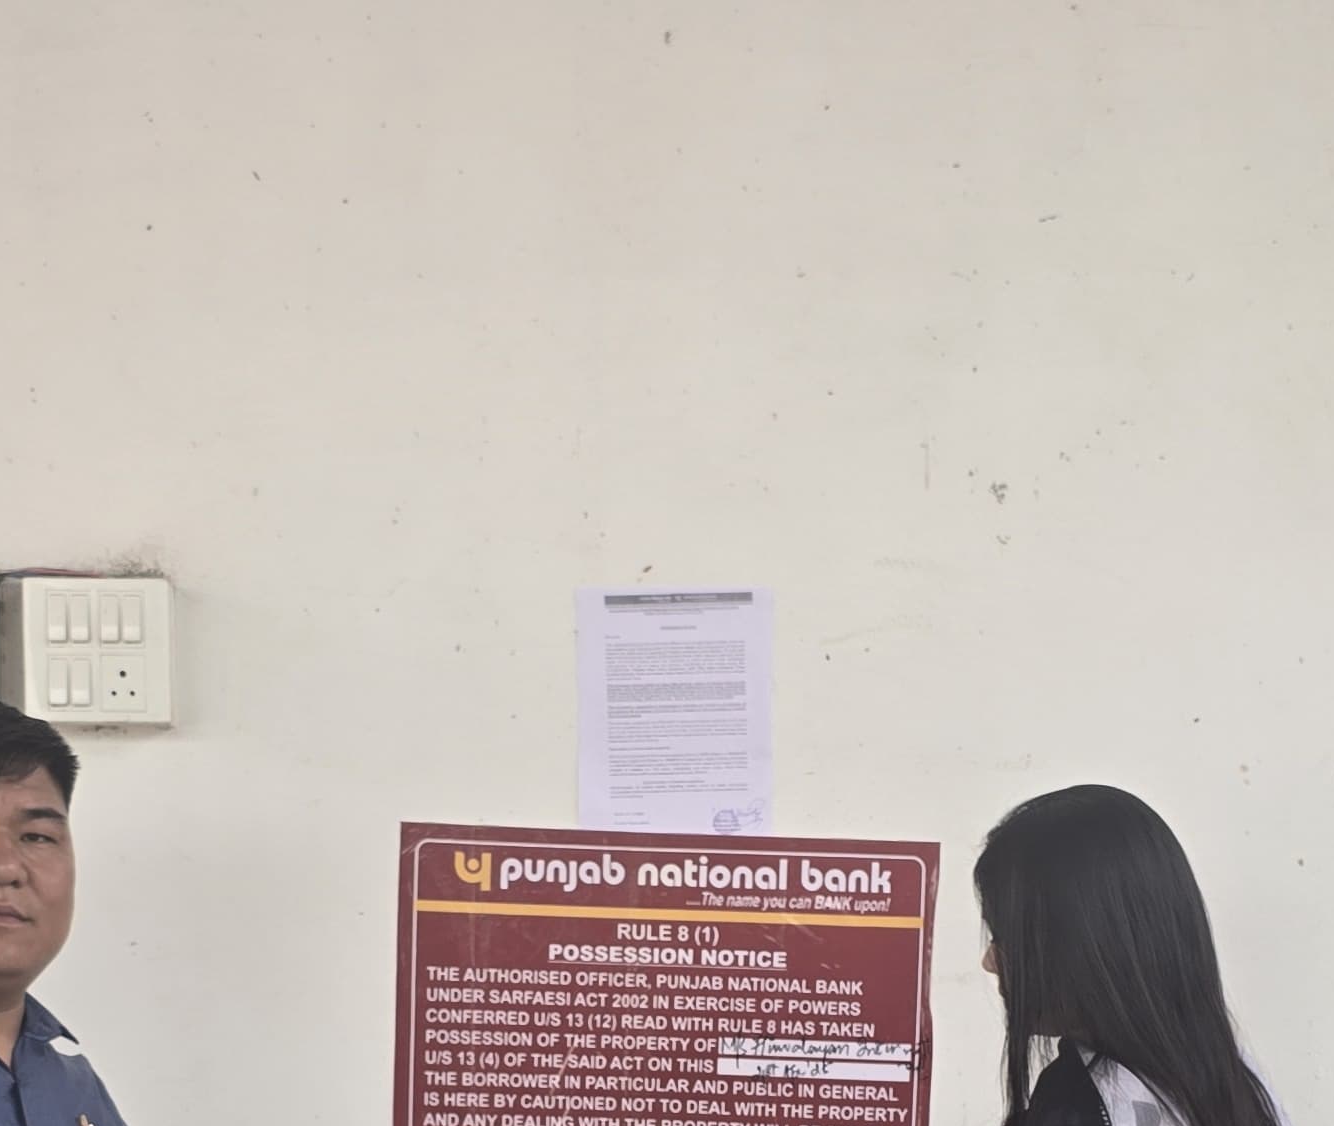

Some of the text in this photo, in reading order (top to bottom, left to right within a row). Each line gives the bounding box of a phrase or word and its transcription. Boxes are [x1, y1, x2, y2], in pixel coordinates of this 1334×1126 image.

[500, 854, 891, 893] punjab national bank
[726, 896, 760, 909] name
[762, 897, 786, 911] you
[789, 898, 811, 910] can
[814, 895, 851, 911] BANK
[854, 898, 891, 913] upon!
[617, 923, 719, 945] RULE 8 (1)
[548, 944, 787, 967] POSSESSION NOTICE
[427, 966, 862, 994] THE AUTHORISED OFFICER, PUNJAB NATIONAL BANK
[427, 987, 860, 1015] UNDER SARFAESI ACT 2002 IN EXERCISE OF POWERS
[425, 1008, 874, 1036] CONFERRED U/S 13 (12) READ WITH RULE 8 HAS TAKEN
[425, 1029, 716, 1051] POSSESSION OF THE PROPERTY OF
[425, 1050, 713, 1072] U/S 13 (4) OF THE SAID ACT ON THIS
[424, 1071, 898, 1099] THE BORROWER IN PARTICULAR AND PUBLIC IN GENERAL
[423, 1112, 459, 1126] AND
[462, 1113, 497, 1126] ANY
[424, 1092, 907, 1121] IS HERE BY CAUTIONED NOT TO DEAL WITH THE PROPERTY
